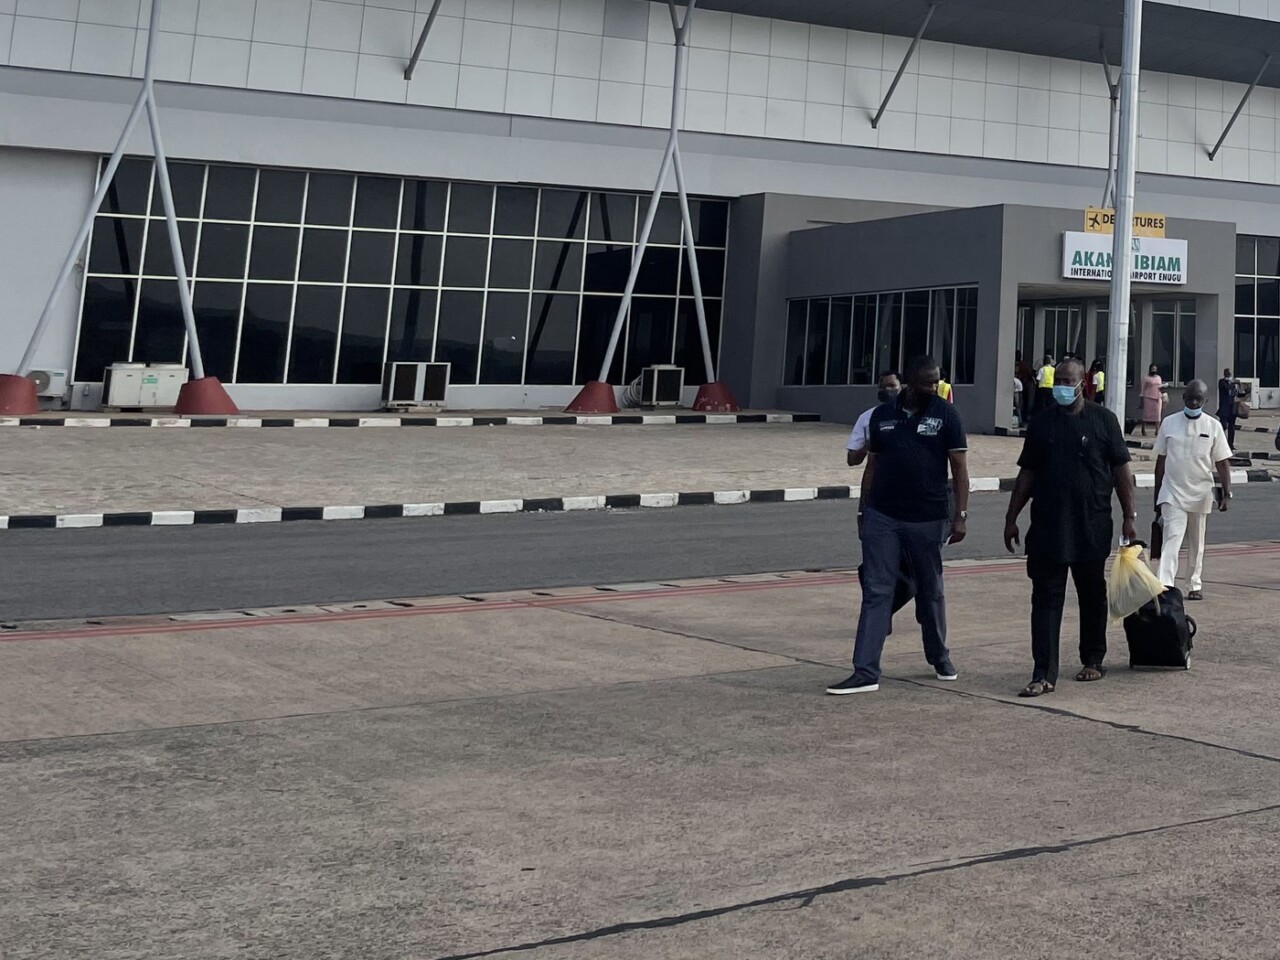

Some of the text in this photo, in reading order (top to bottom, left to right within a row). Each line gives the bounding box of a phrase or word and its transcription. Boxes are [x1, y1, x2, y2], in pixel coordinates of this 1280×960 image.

[1102, 213, 1164, 229] DETURES
[1134, 254, 1181, 272] IBIAM
[1070, 267, 1182, 282] INTERNATIO IRPORT ENUGU
